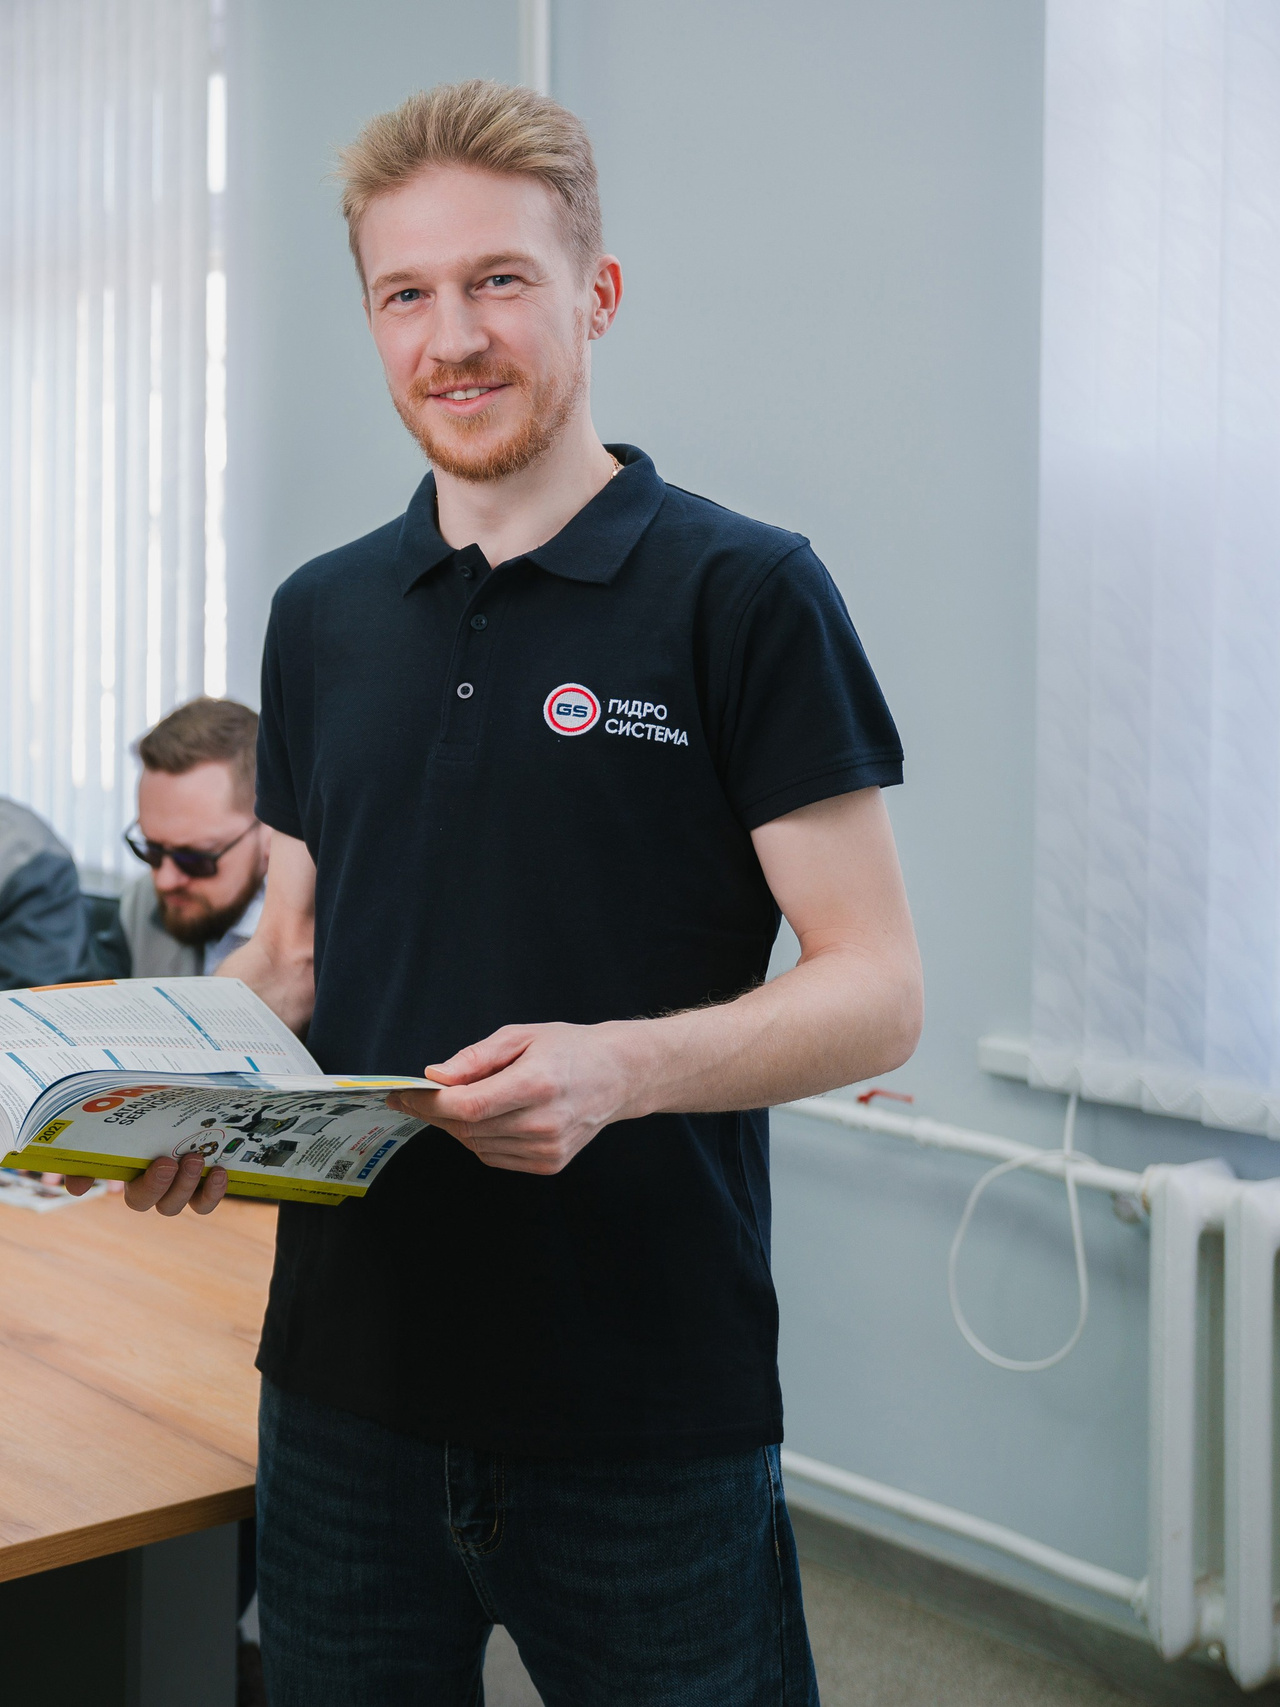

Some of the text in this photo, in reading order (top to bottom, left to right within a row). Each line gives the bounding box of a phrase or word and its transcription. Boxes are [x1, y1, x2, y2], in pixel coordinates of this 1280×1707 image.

[556, 703, 588, 718] GS
[608, 698, 668, 721] ГИДРО
[604, 718, 689, 747] СИСТЕМА
[38, 1121, 66, 1142] 2021
